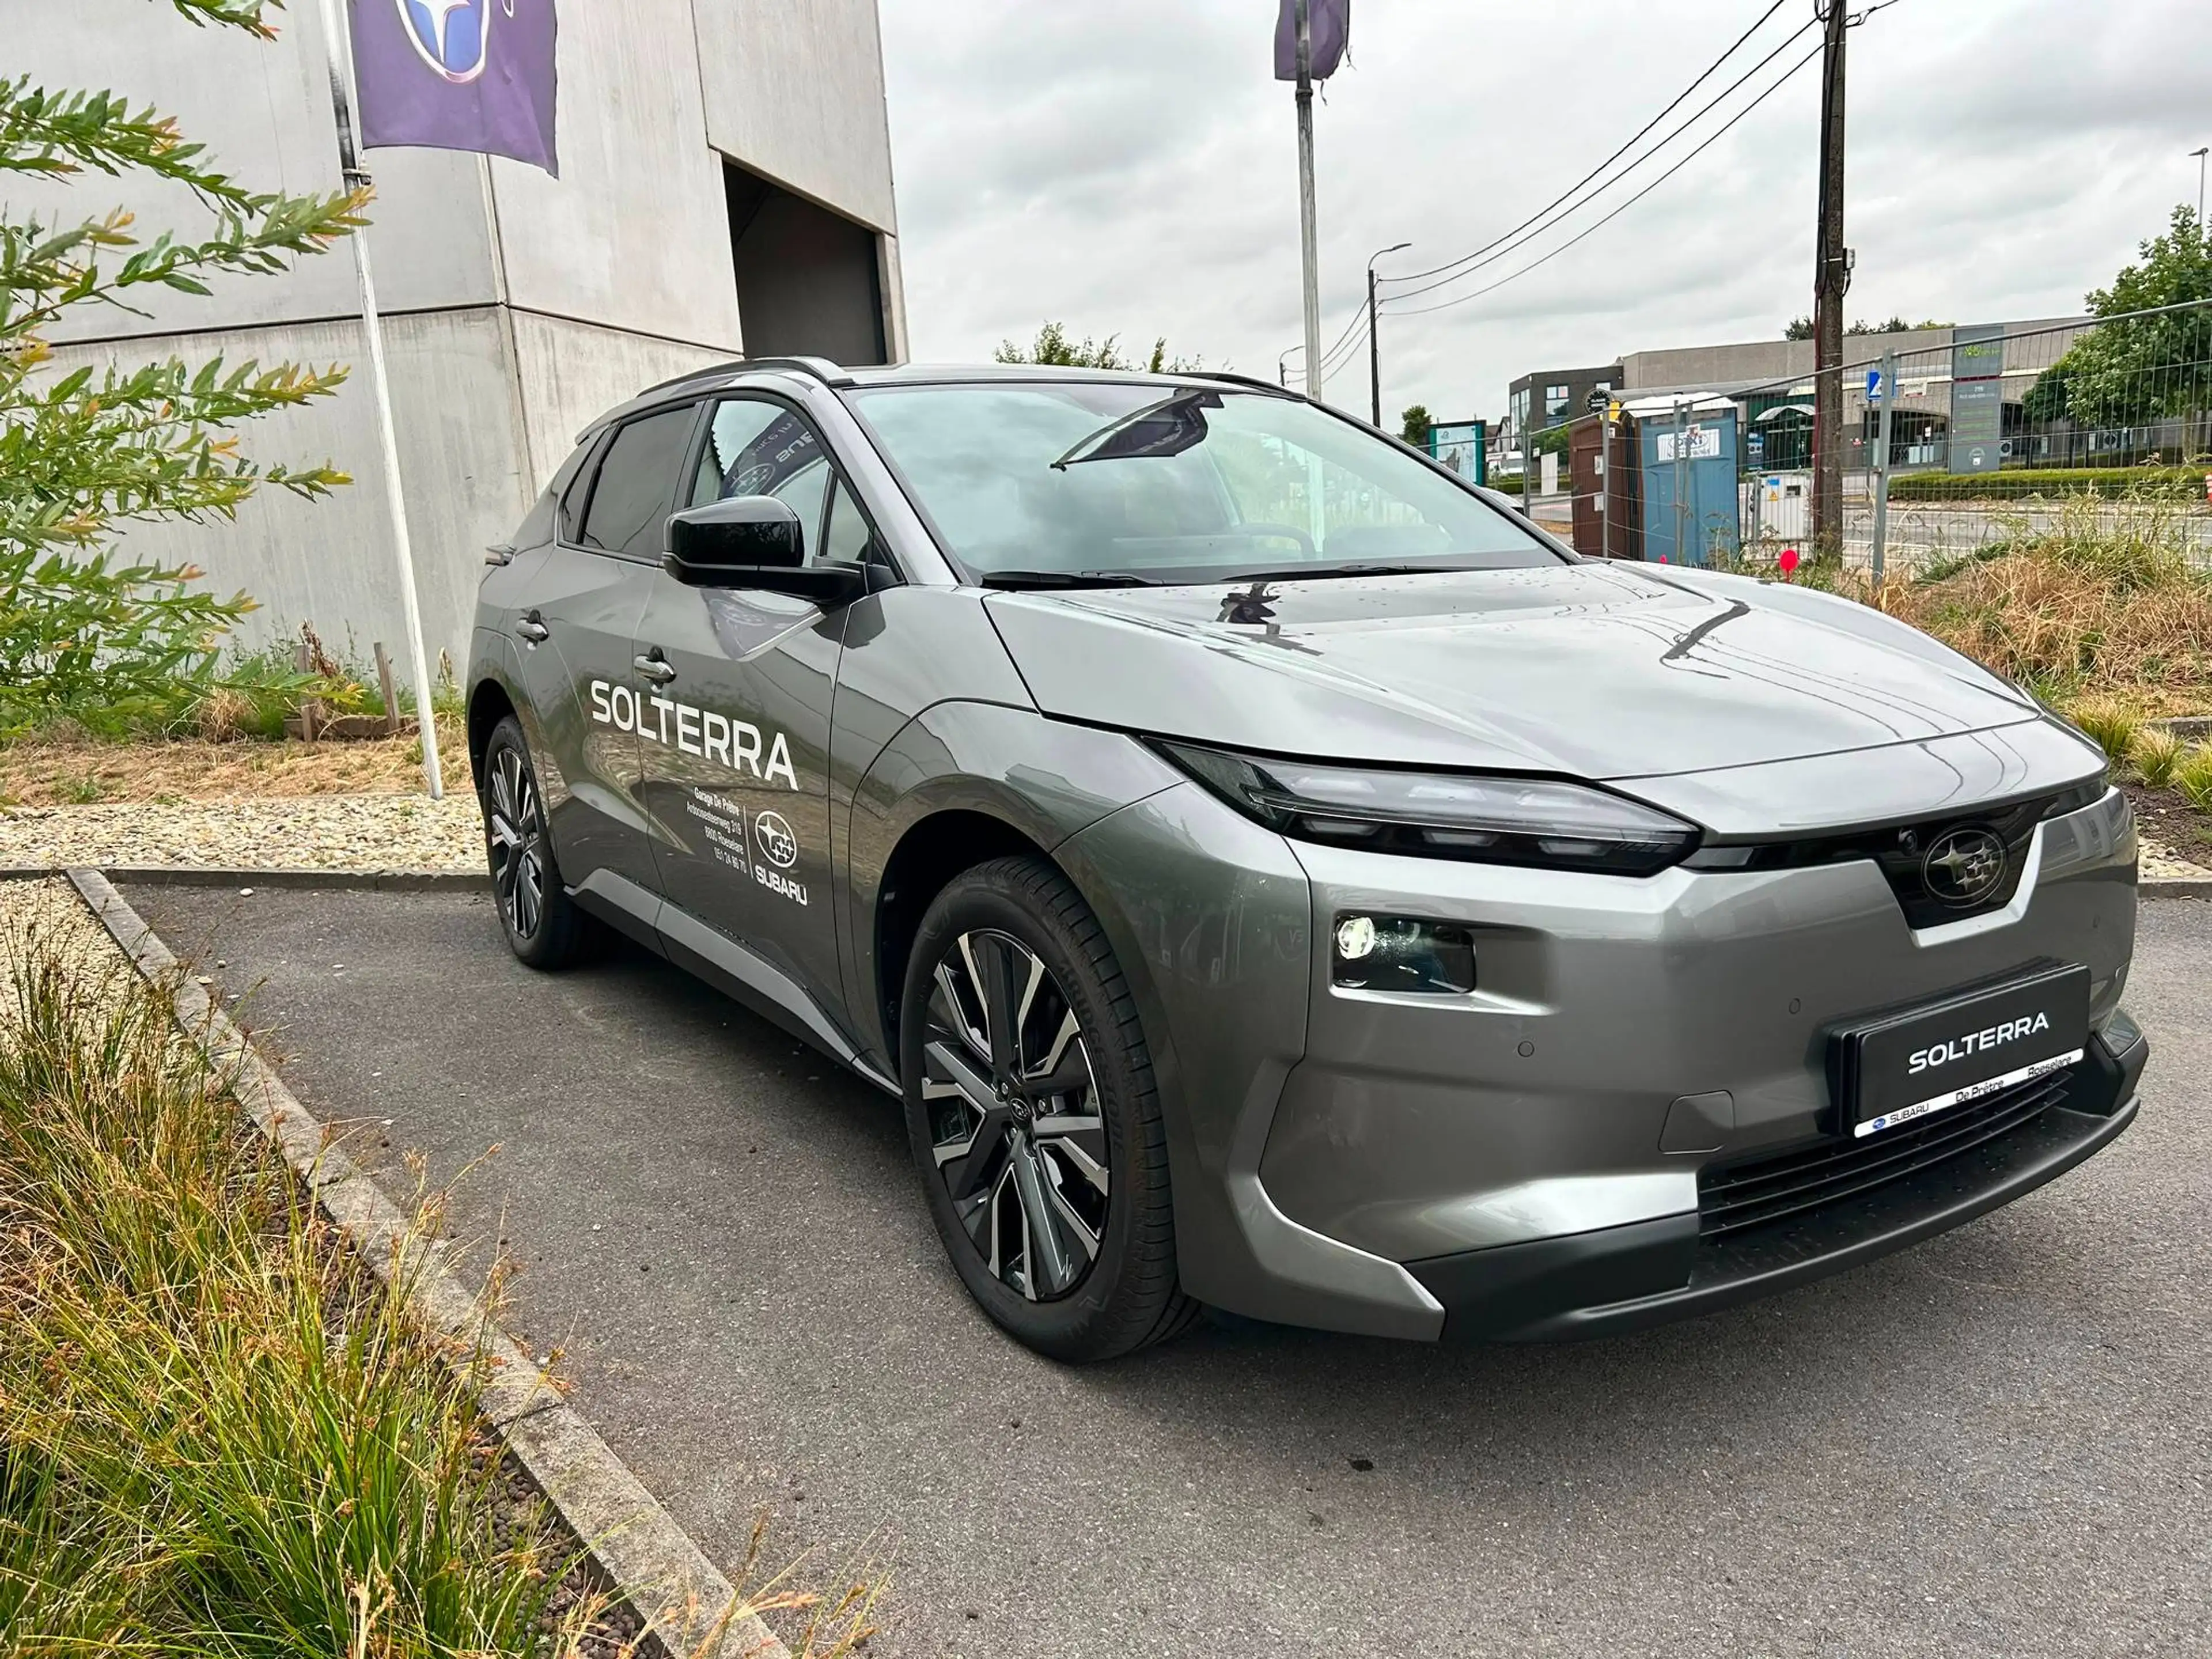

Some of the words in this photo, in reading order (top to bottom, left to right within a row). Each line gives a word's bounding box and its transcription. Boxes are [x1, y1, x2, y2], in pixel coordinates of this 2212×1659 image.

[591, 680, 799, 791] SOLTERRA
[755, 865, 808, 906] SUBARU
[1908, 1012, 2049, 1074] SOLTERRA
[1890, 1103, 1929, 1123] SUBARU
[1956, 1091, 1969, 1103] De
[2028, 1055, 2071, 1077] Roeselare
